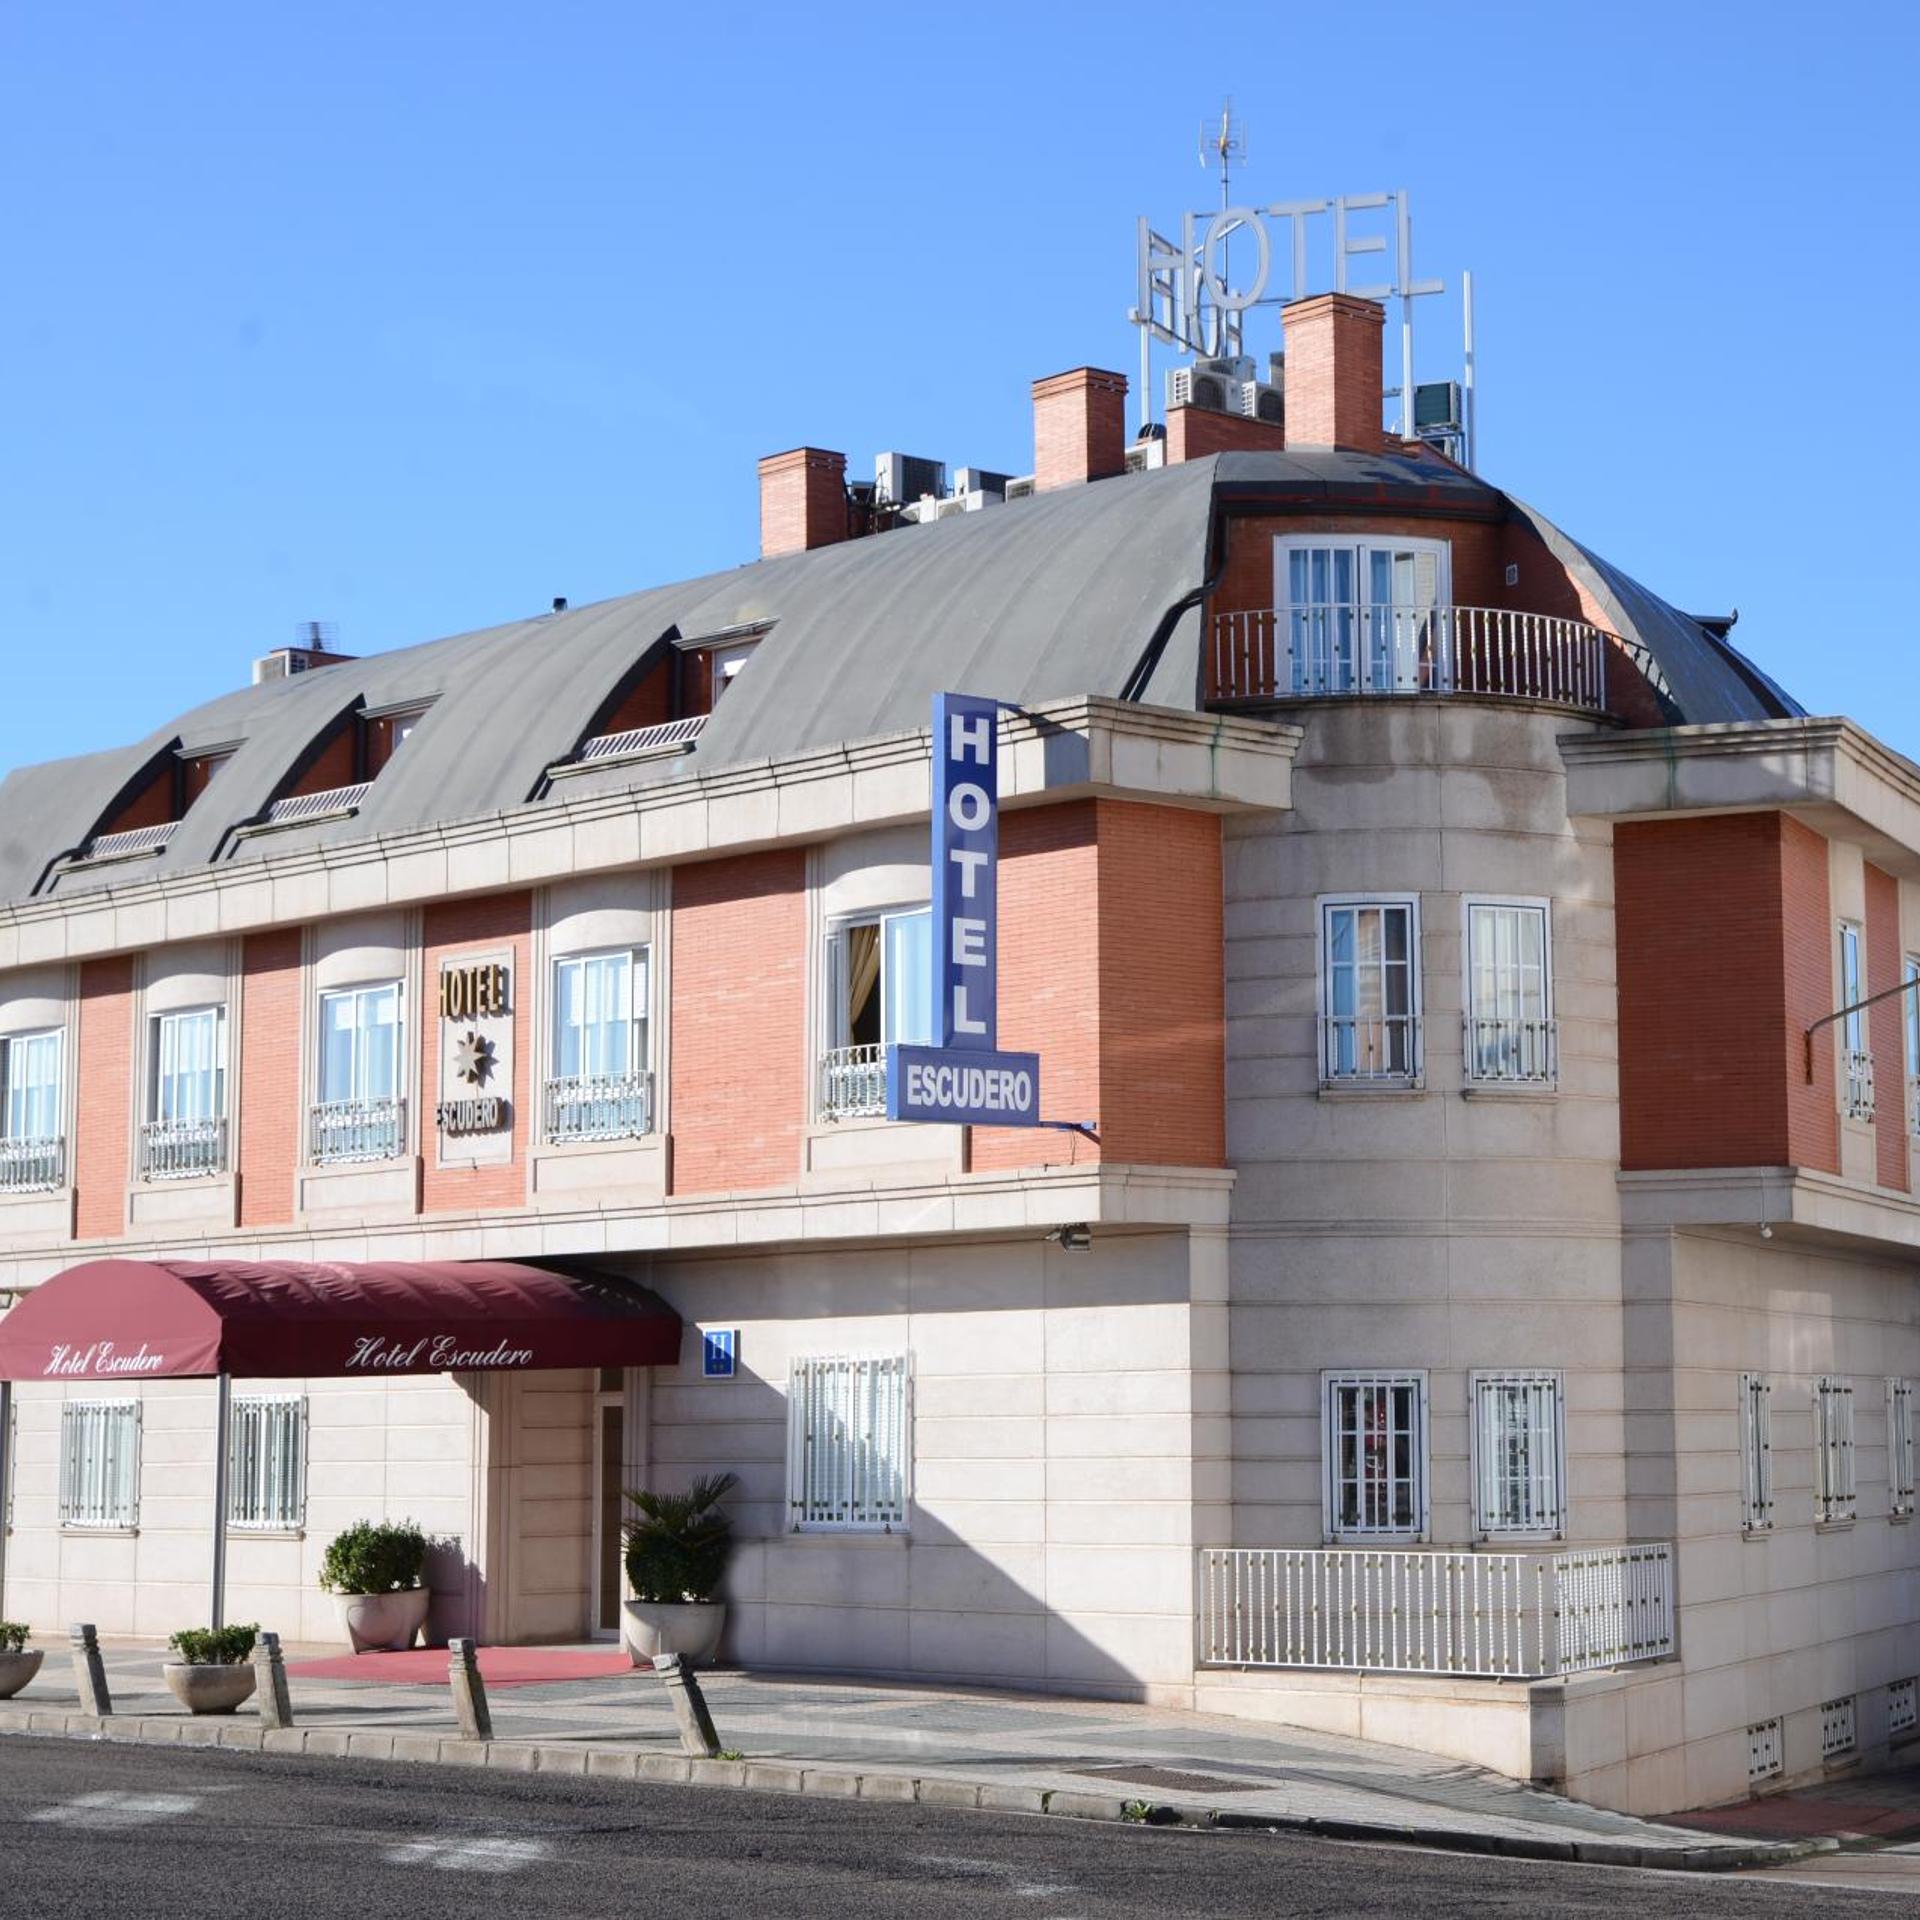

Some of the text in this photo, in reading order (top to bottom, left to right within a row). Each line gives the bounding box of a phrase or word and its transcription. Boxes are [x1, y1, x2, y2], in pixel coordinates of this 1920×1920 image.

[1136, 190, 1445, 322] HOTEL
[949, 714, 991, 1035] HOTEL
[439, 964, 500, 1017] HOTEL
[906, 1064, 1031, 1112] ESCUDERO
[436, 1097, 499, 1131] ESCUDERO
[43, 1341, 164, 1375] Hotel Escudero
[345, 1334, 533, 1368] Hotel Escudero
